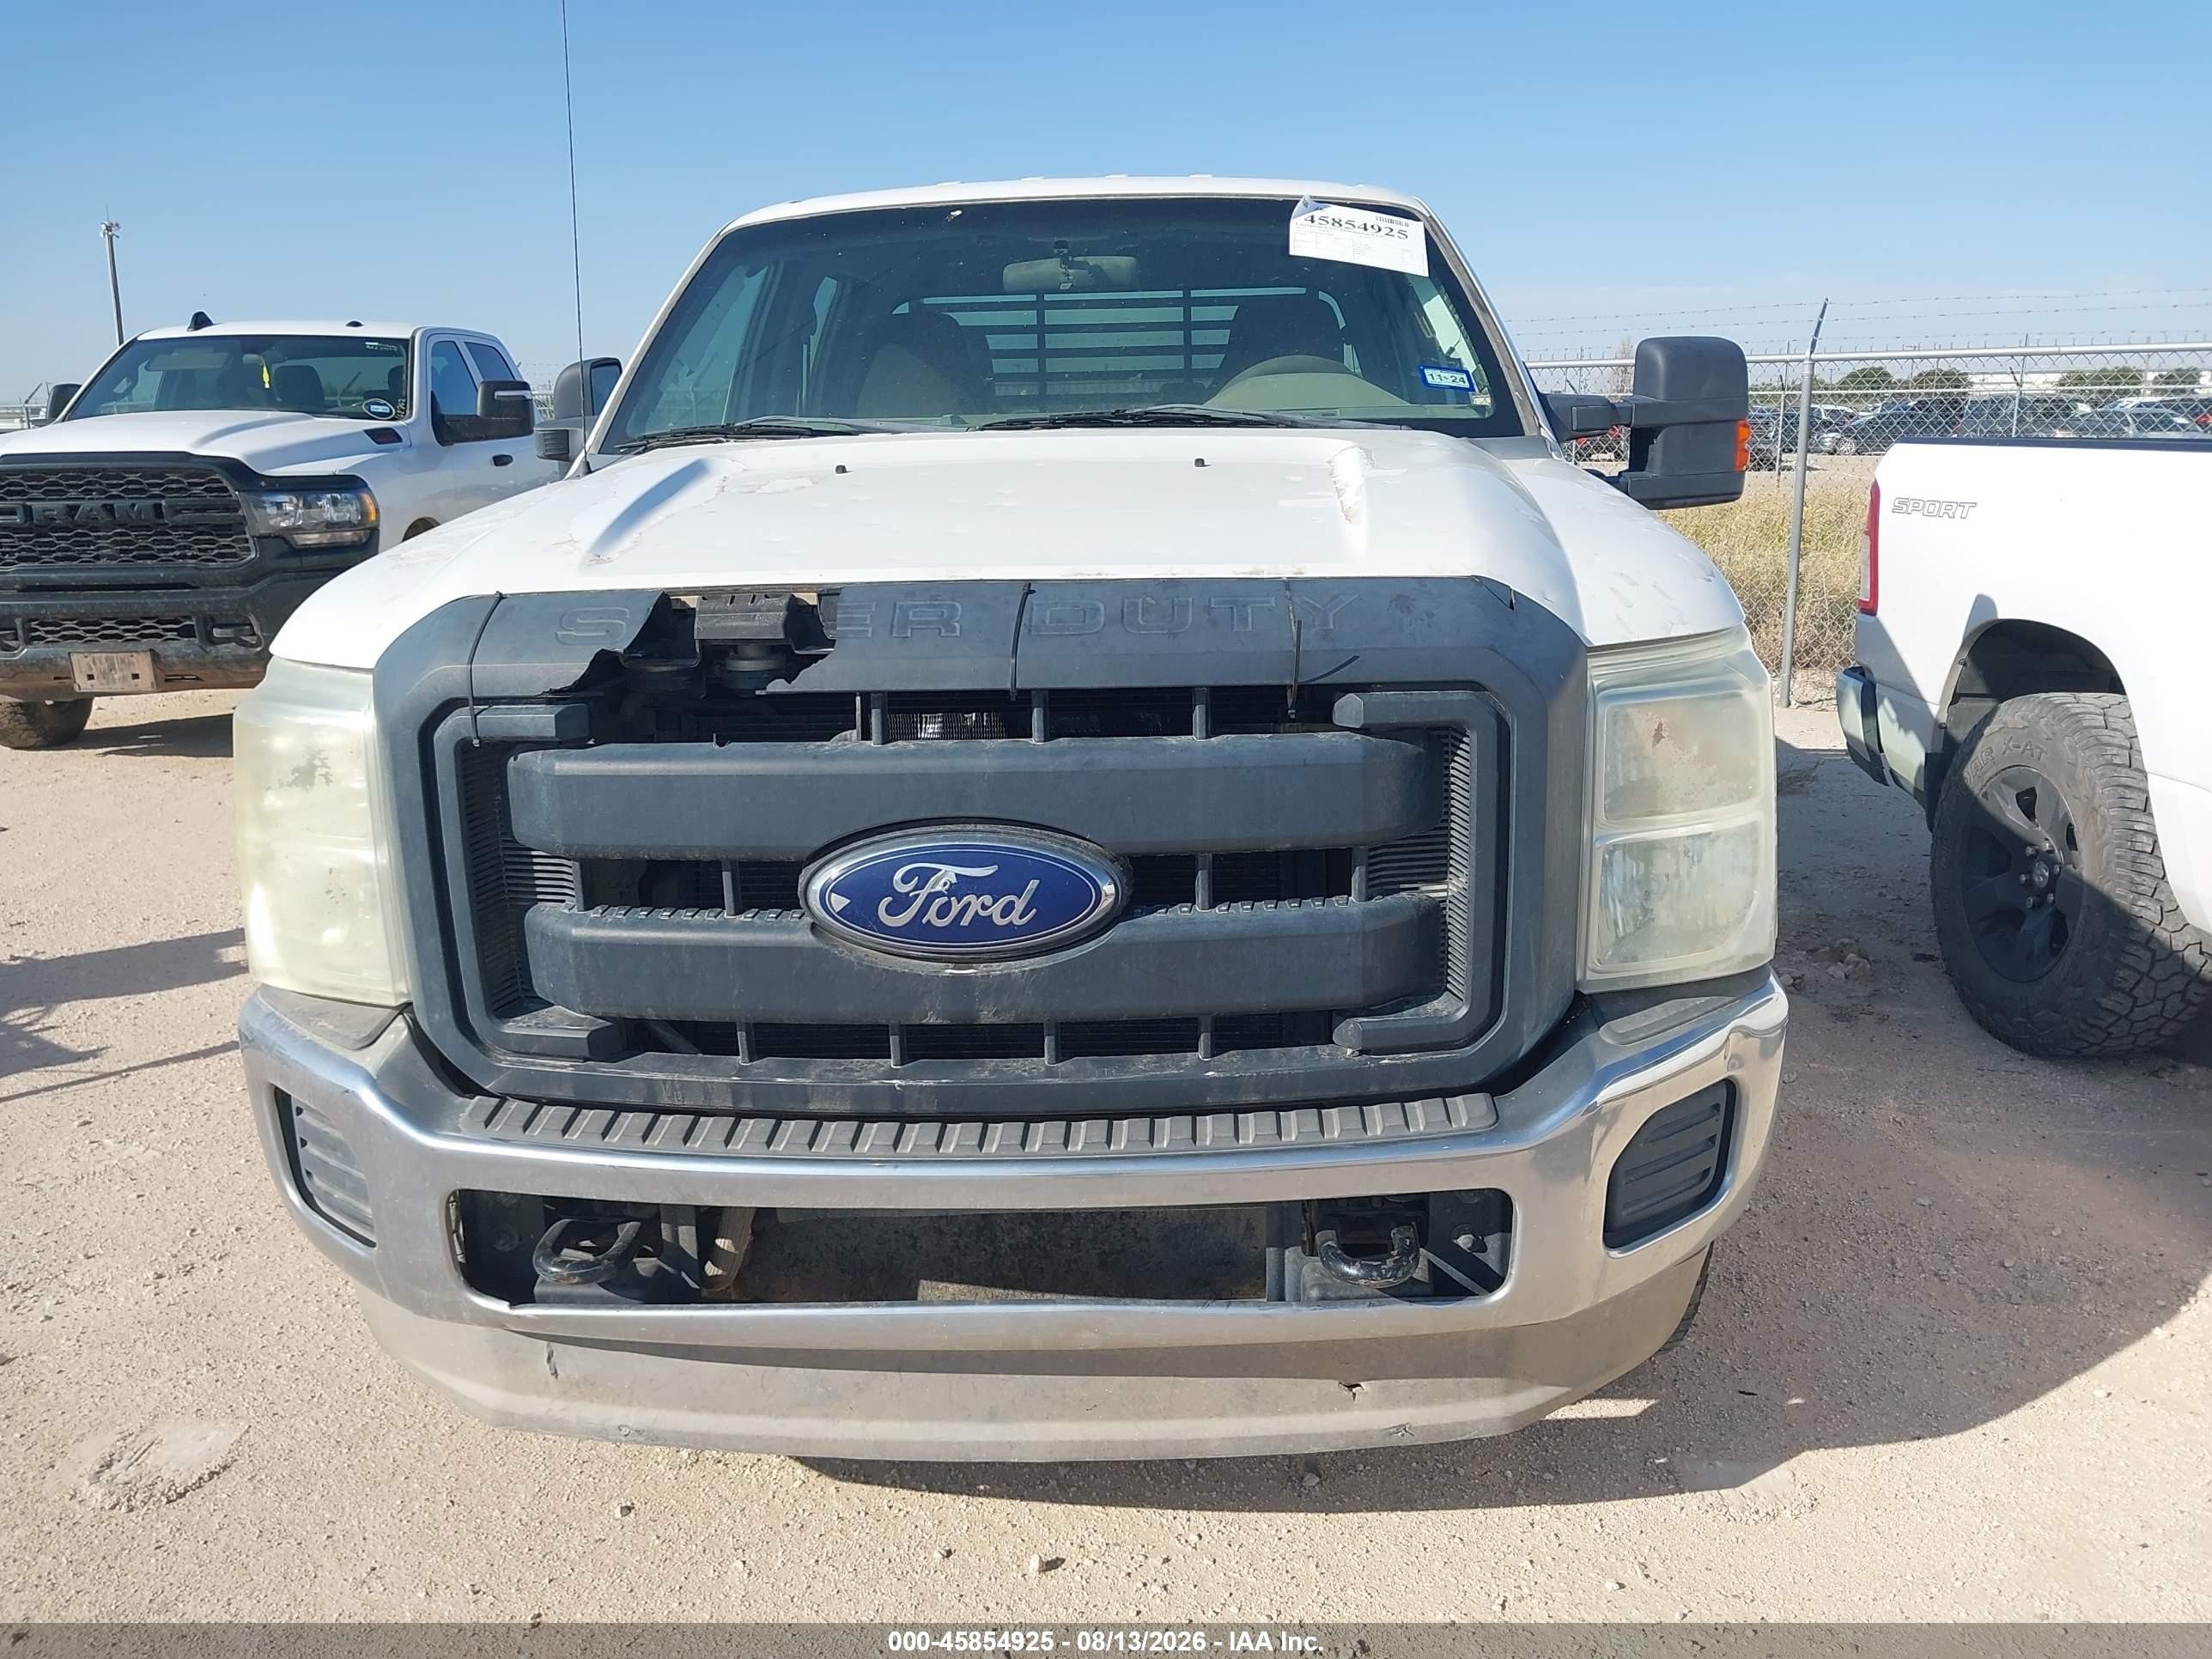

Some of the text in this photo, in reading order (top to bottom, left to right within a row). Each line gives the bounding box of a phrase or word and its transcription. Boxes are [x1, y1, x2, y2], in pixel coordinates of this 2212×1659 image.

[1304, 214, 1409, 240] 45854925
[32, 501, 165, 525] RAM
[1892, 497, 1978, 519] SPORT
[556, 592, 1361, 639] SER DUTY
[878, 861, 1040, 927] Ford
